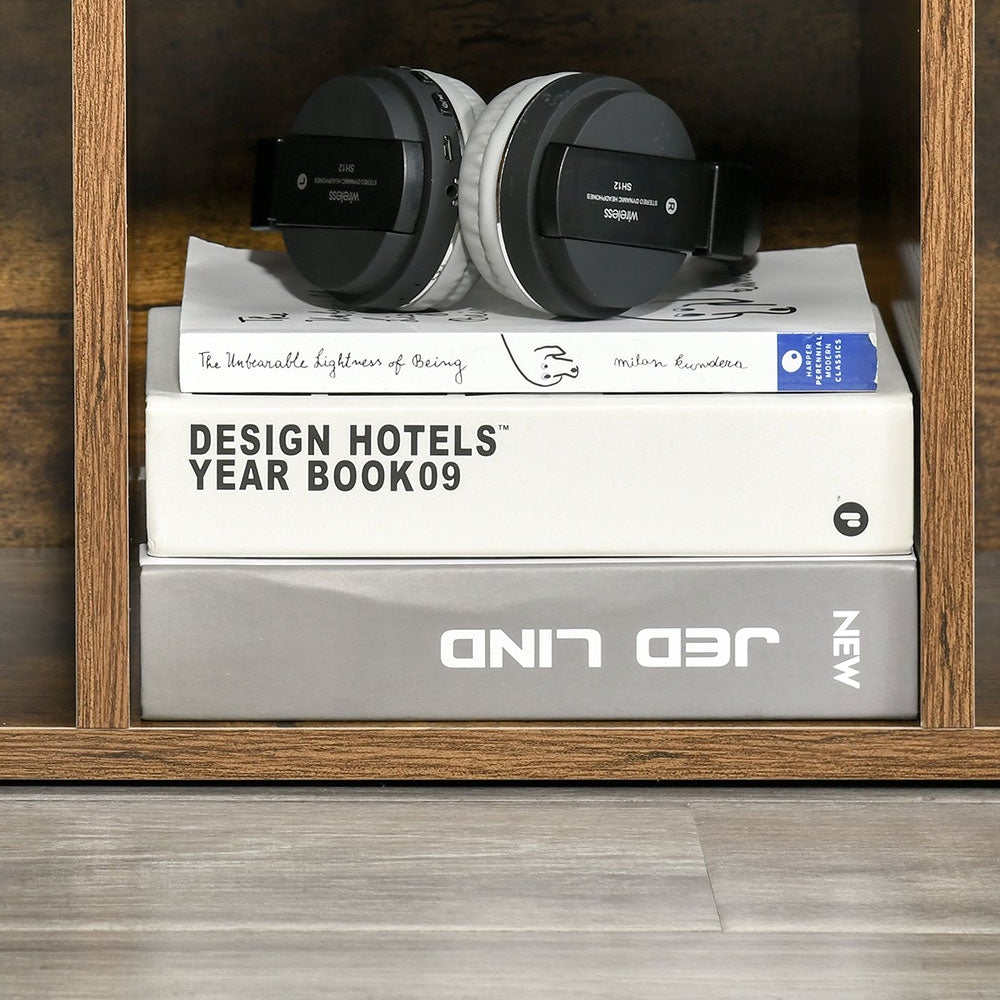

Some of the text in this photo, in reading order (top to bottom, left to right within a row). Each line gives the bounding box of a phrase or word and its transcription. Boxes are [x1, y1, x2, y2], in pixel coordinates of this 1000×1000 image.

[338, 163, 355, 173] SH12
[613, 181, 633, 191] SH12
[328, 190, 360, 203] wireless
[586, 193, 658, 206] STEREO DYNAMIC HEADPHONES
[603, 208, 638, 222] wireless
[199, 348, 467, 384] The Unbearable Lightness of Being
[613, 354, 748, 370] milan kundera
[190, 424, 330, 456] DESIGN
[189, 459, 461, 491] YEAR BOOK09
[440, 627, 780, 668] JED LIND
[832, 610, 861, 689] NEW
